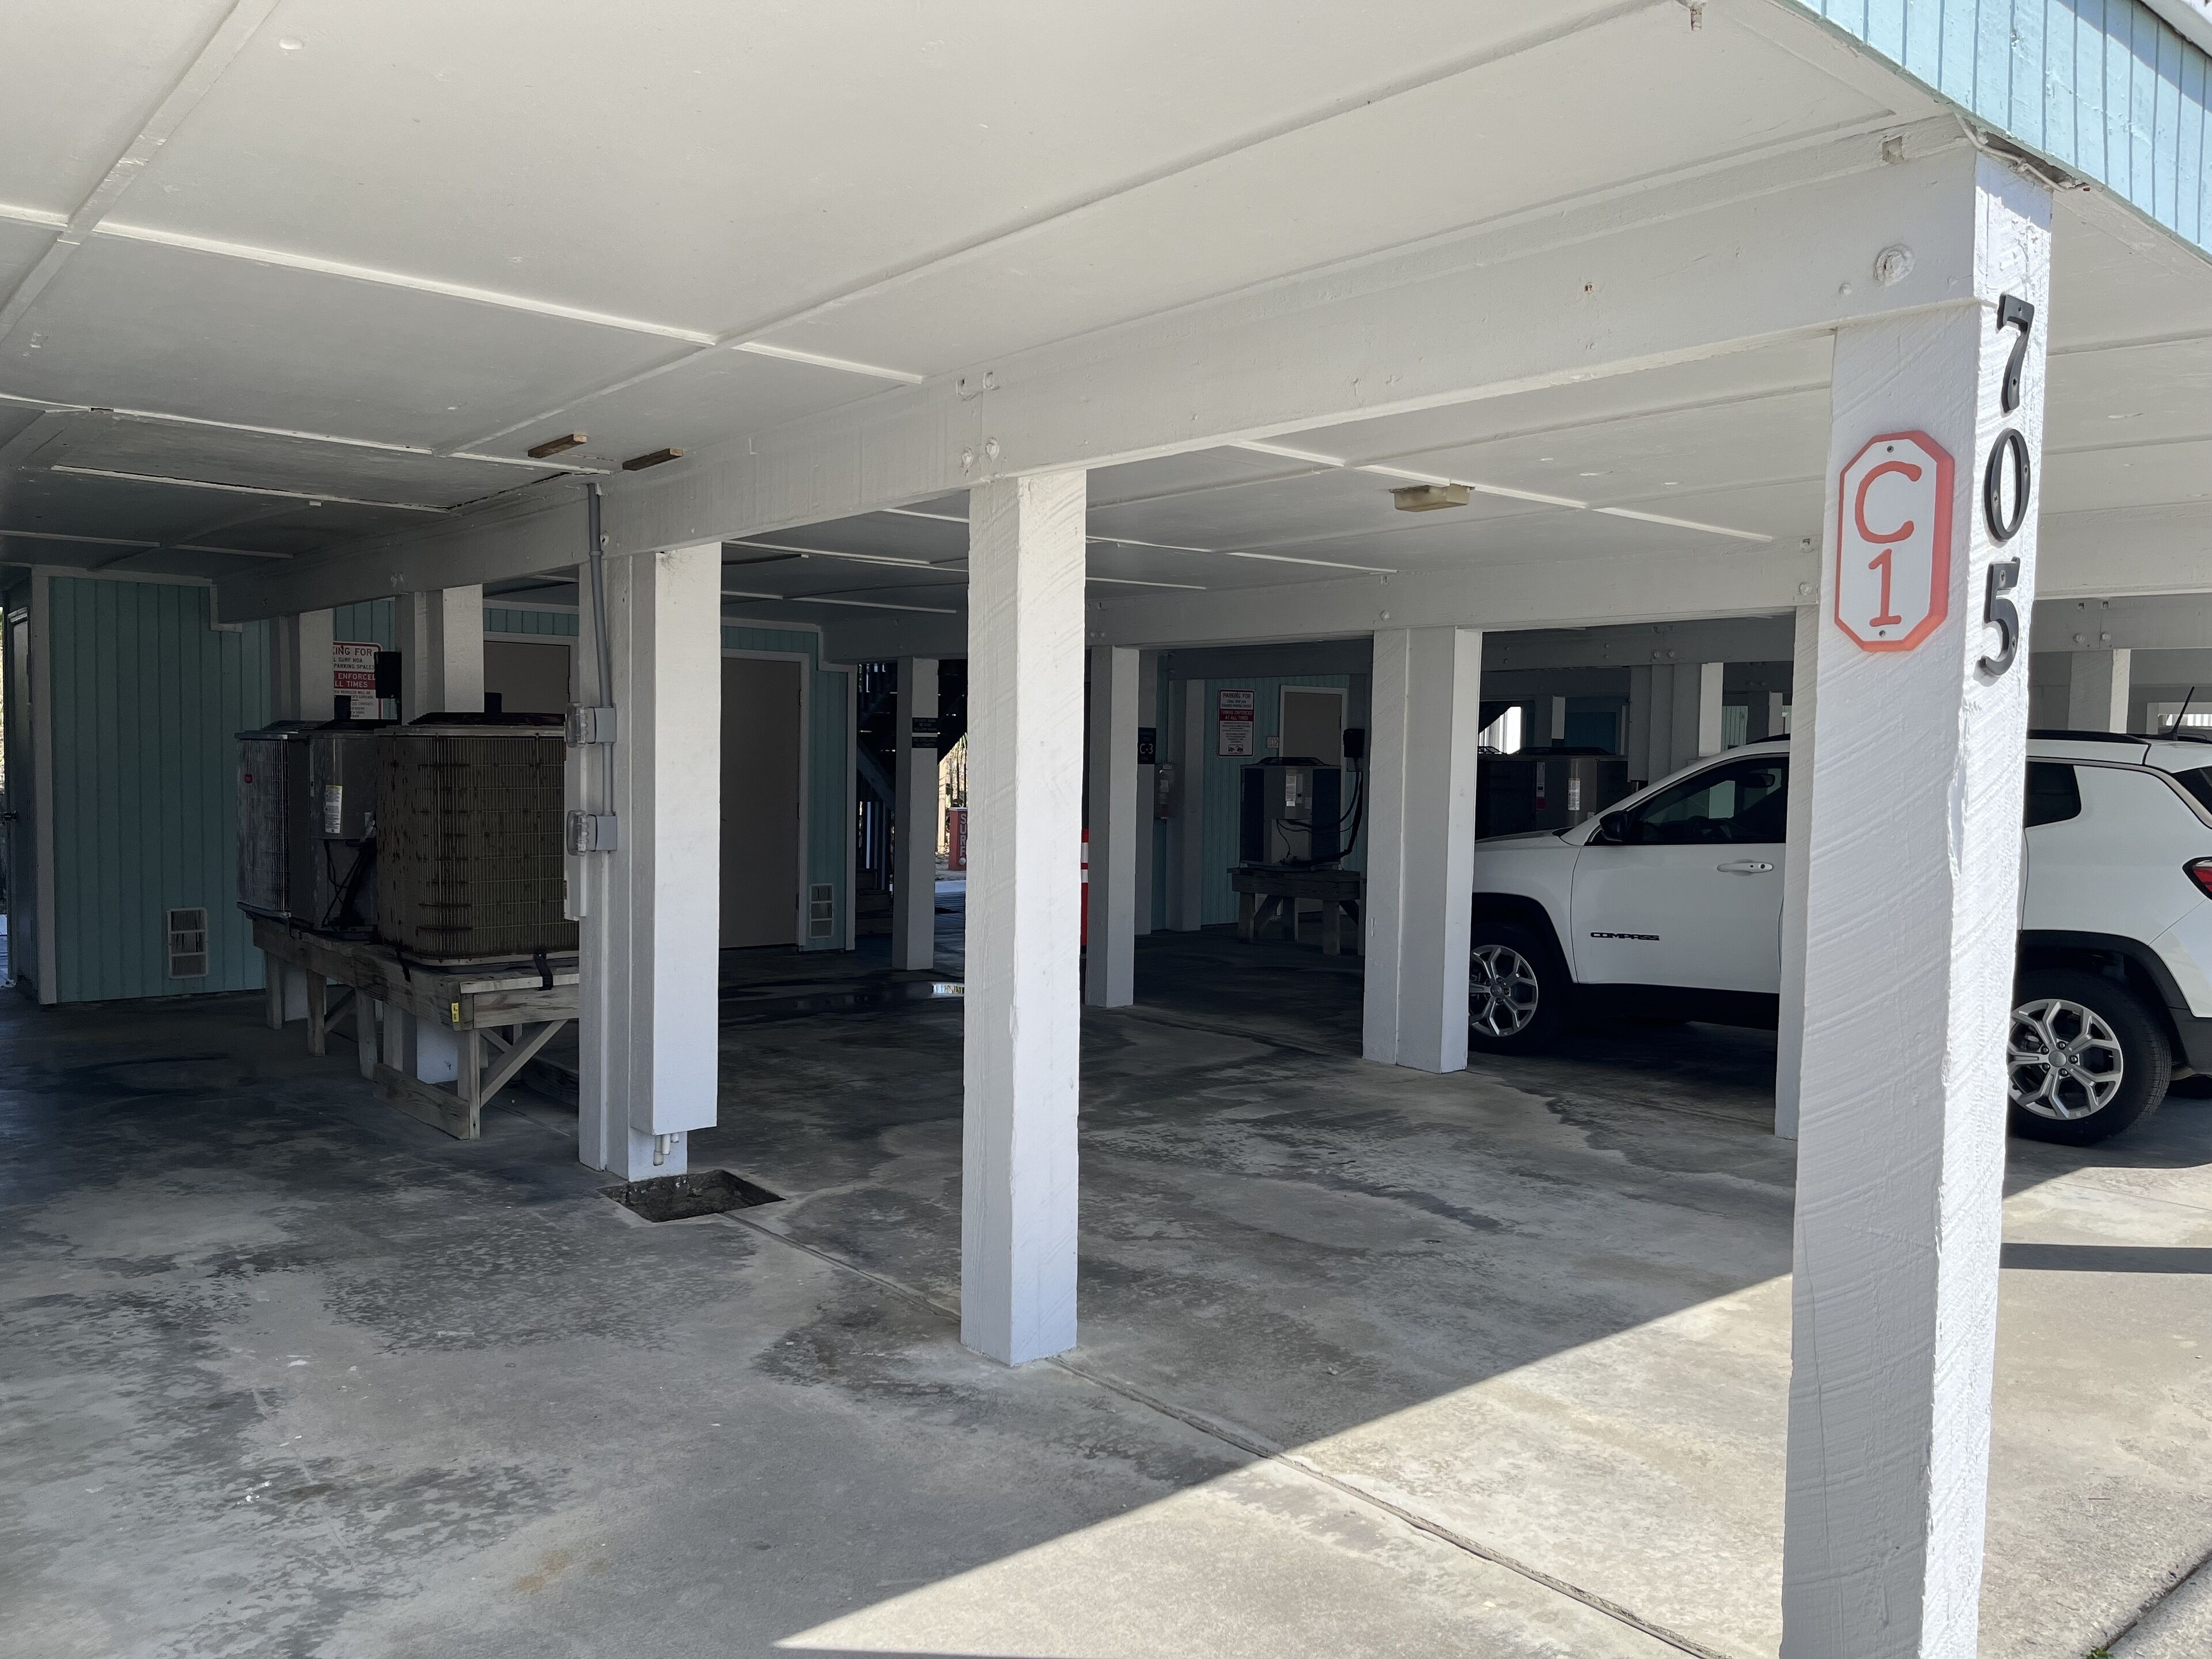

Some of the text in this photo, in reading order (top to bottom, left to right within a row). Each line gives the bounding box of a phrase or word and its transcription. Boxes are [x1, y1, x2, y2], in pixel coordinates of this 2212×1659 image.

[1978, 293, 2035, 677] 705
[355, 648, 372, 657] FOR
[1139, 743, 1153, 755] C-3
[1590, 932, 1660, 941] COMPASS
